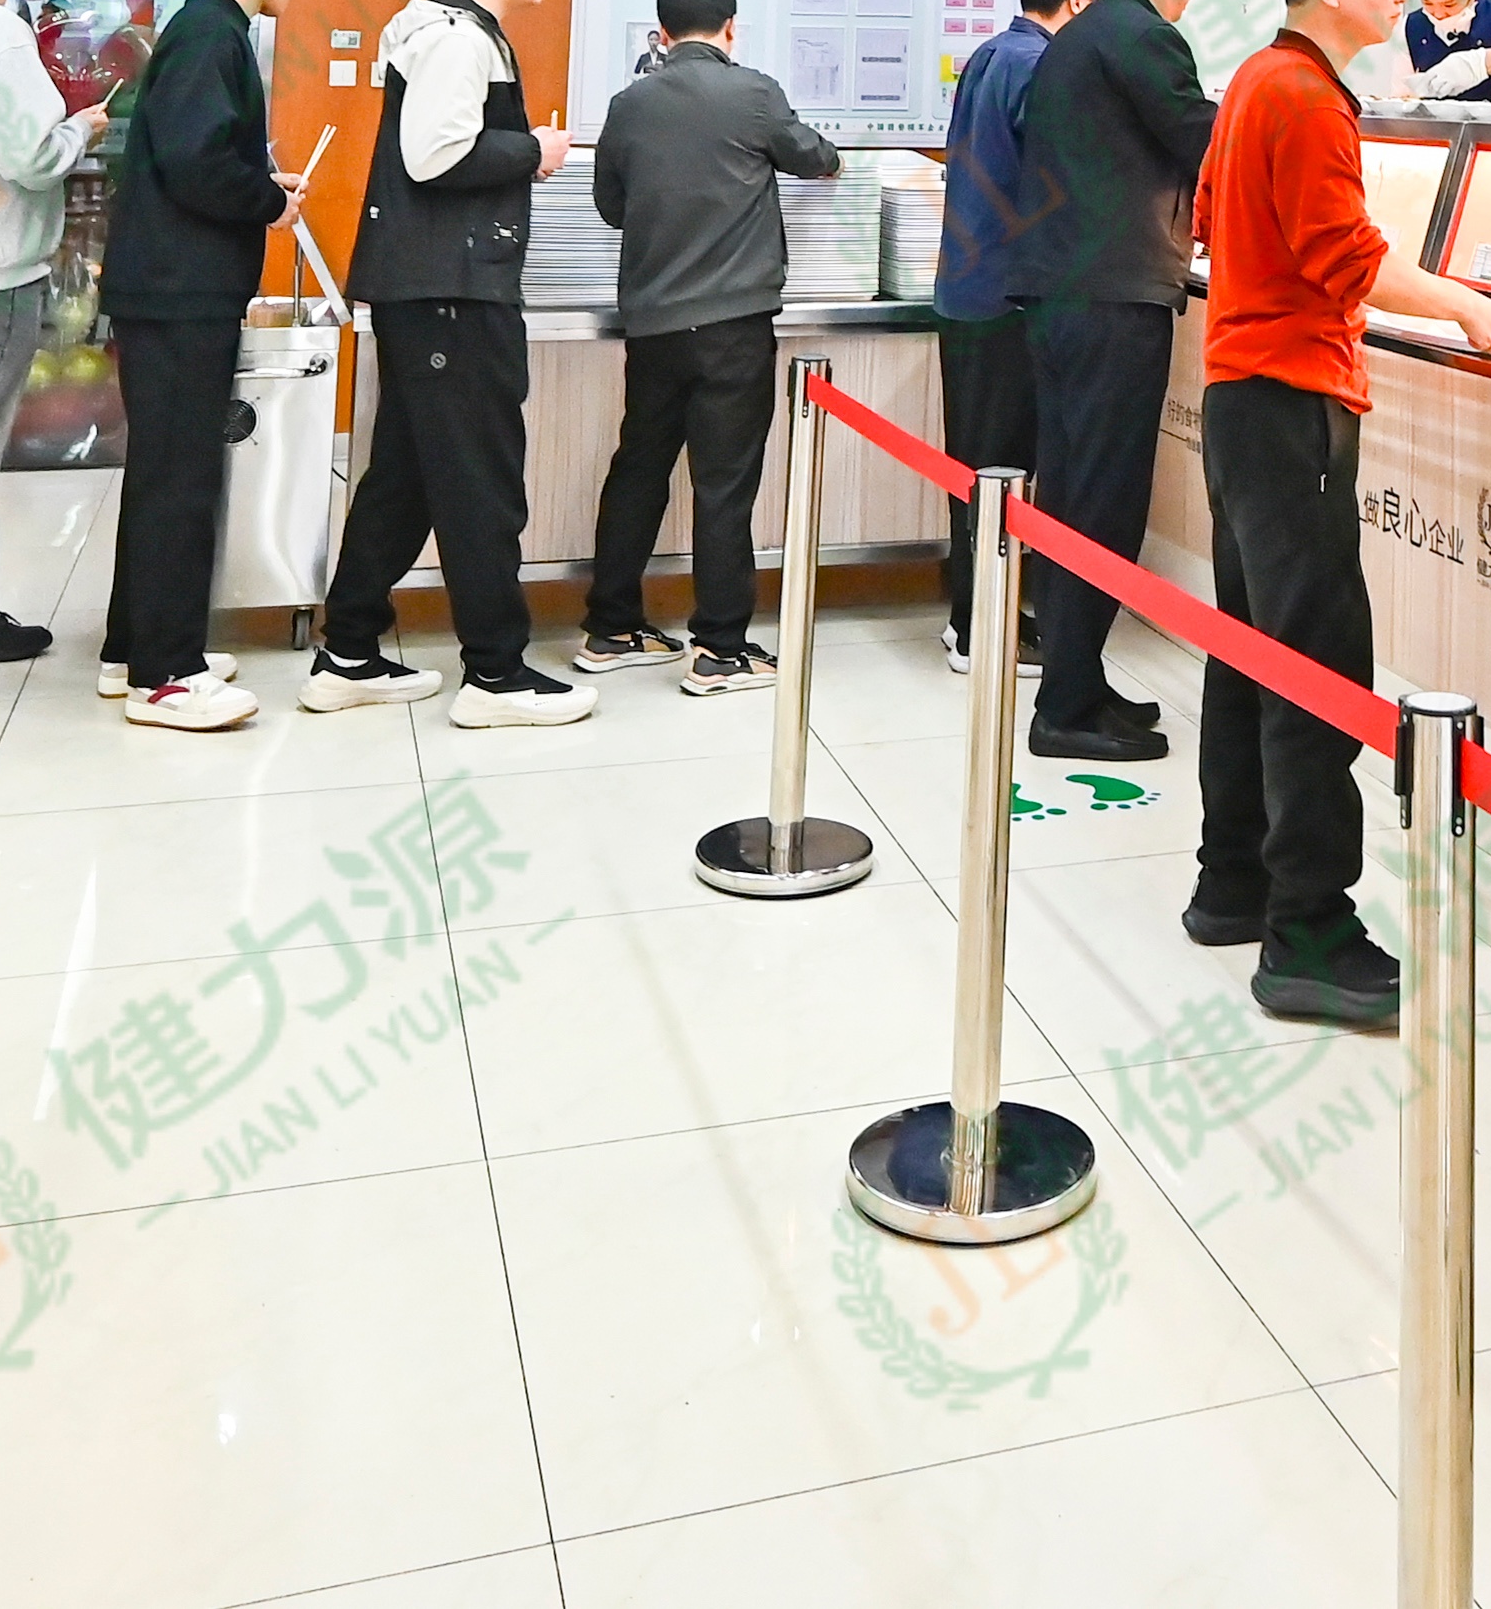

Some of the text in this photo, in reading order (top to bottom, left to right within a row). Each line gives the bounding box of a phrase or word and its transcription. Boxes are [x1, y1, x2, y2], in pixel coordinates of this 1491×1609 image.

[1363, 487, 1464, 565] 做良心企业
